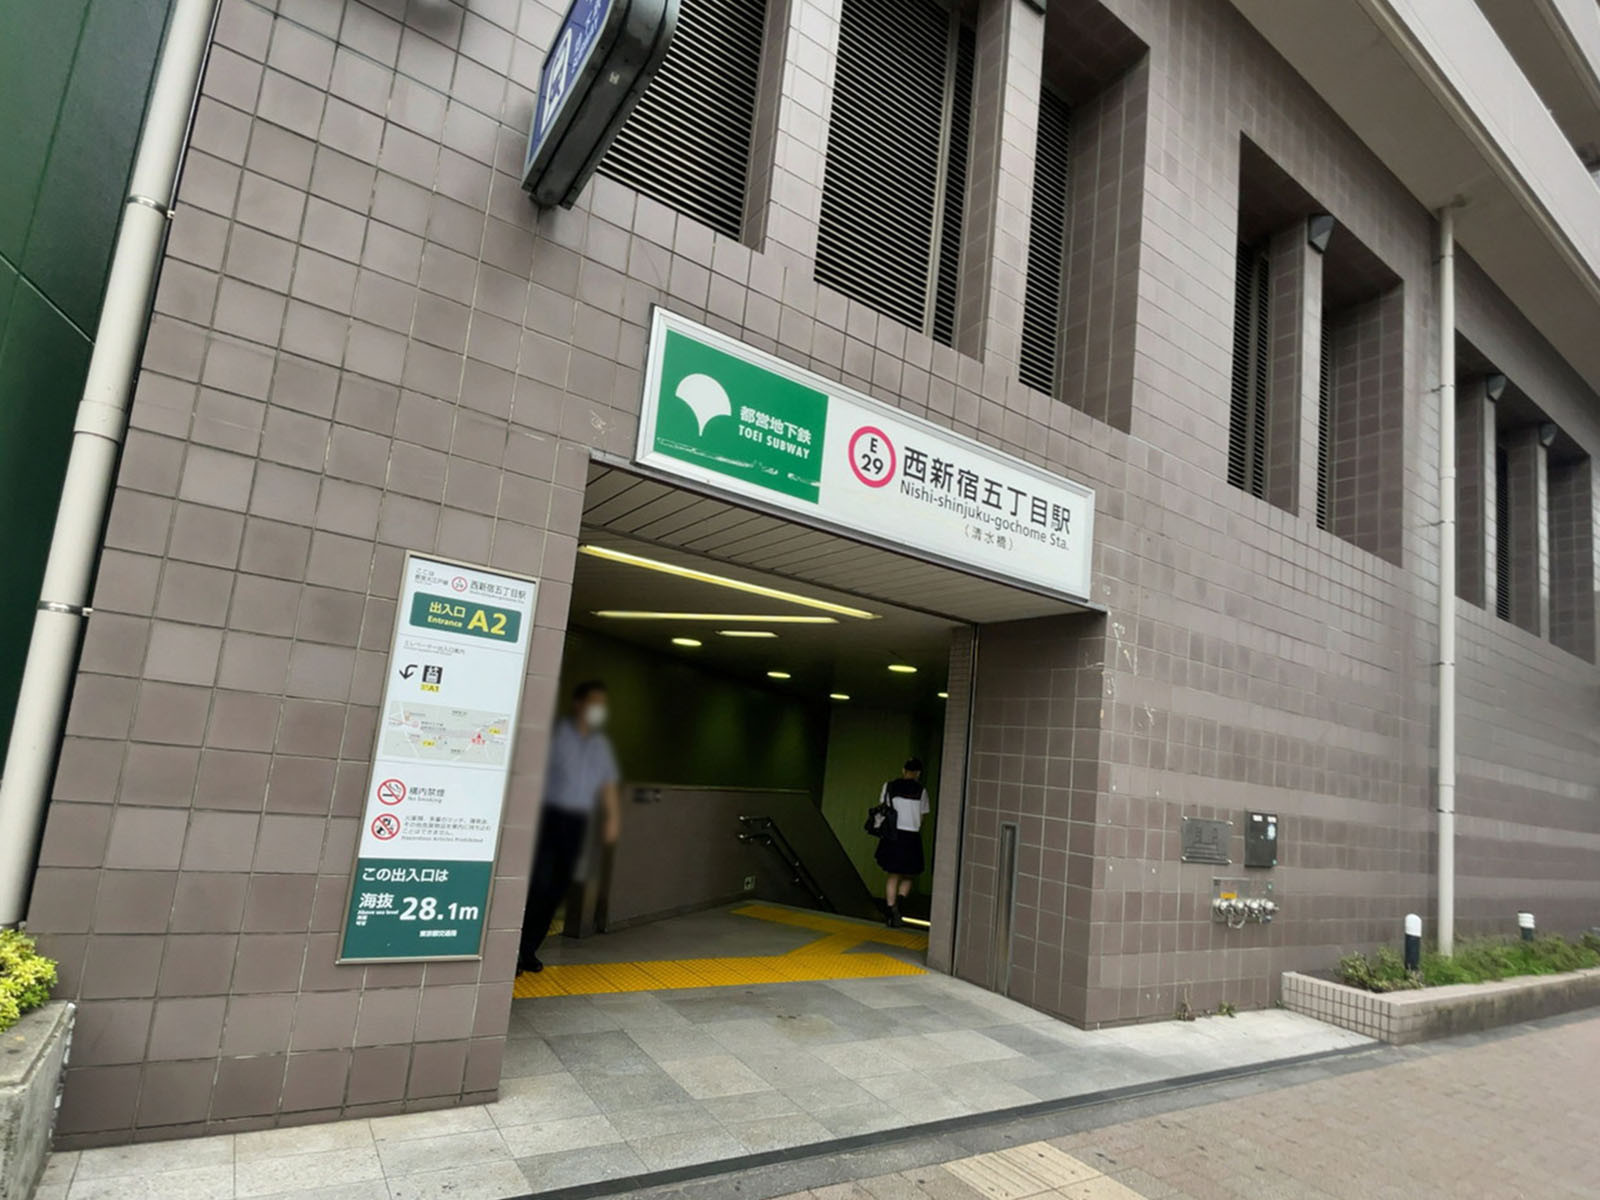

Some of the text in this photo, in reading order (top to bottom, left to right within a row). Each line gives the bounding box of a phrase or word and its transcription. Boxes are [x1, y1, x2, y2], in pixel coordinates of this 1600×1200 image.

[740, 406, 812, 445] 都営地下鉄
[738, 424, 810, 459] TOEI SUBWAY
[870, 438, 878, 454] E
[861, 453, 884, 475] 29
[903, 446, 1071, 535] 西新宿五丁目駅
[900, 480, 1070, 551] Nishi-shinjuku-gochome Sta.
[470, 580, 526, 600] 西新宿五丁目駅
[427, 615, 463, 628] Entrance
[429, 601, 466, 618] 出入口
[467, 610, 507, 636] A2
[362, 868, 449, 882] この出入口は
[359, 893, 478, 921] 海抜 28.1m
